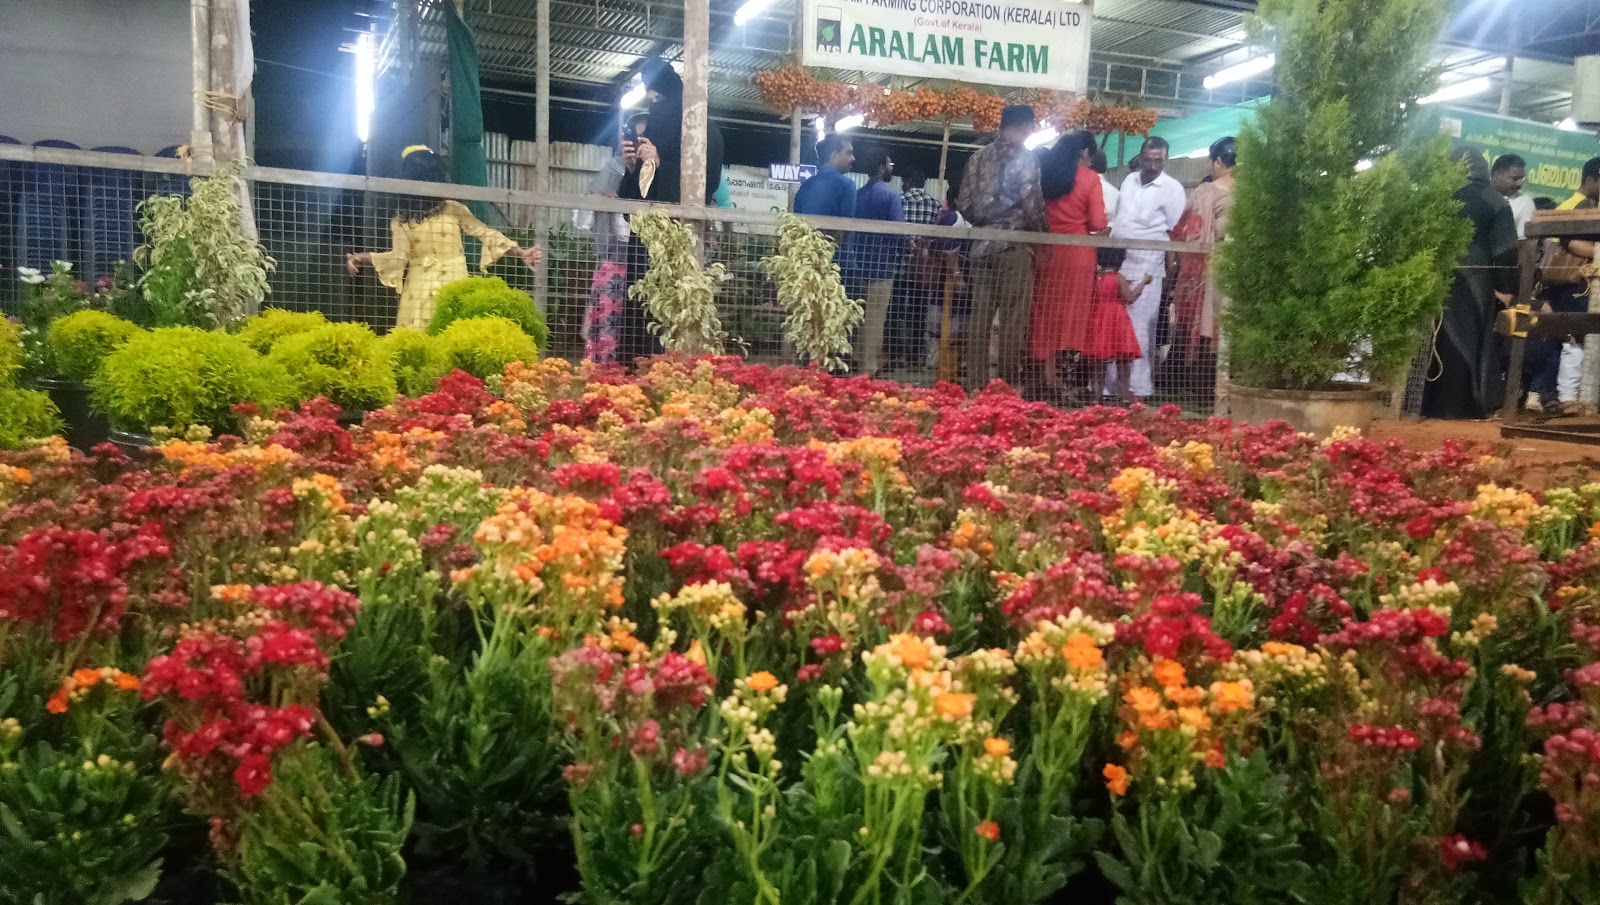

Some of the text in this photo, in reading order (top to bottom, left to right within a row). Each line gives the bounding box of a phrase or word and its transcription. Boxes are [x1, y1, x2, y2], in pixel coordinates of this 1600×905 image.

[919, 0, 1000, 21] CORPORATION
[1003, 7, 1056, 28] (KERALA)
[953, 20, 982, 33] Kerala)
[847, 23, 1049, 74] ARALAM FARM
[771, 164, 800, 180] WAY
